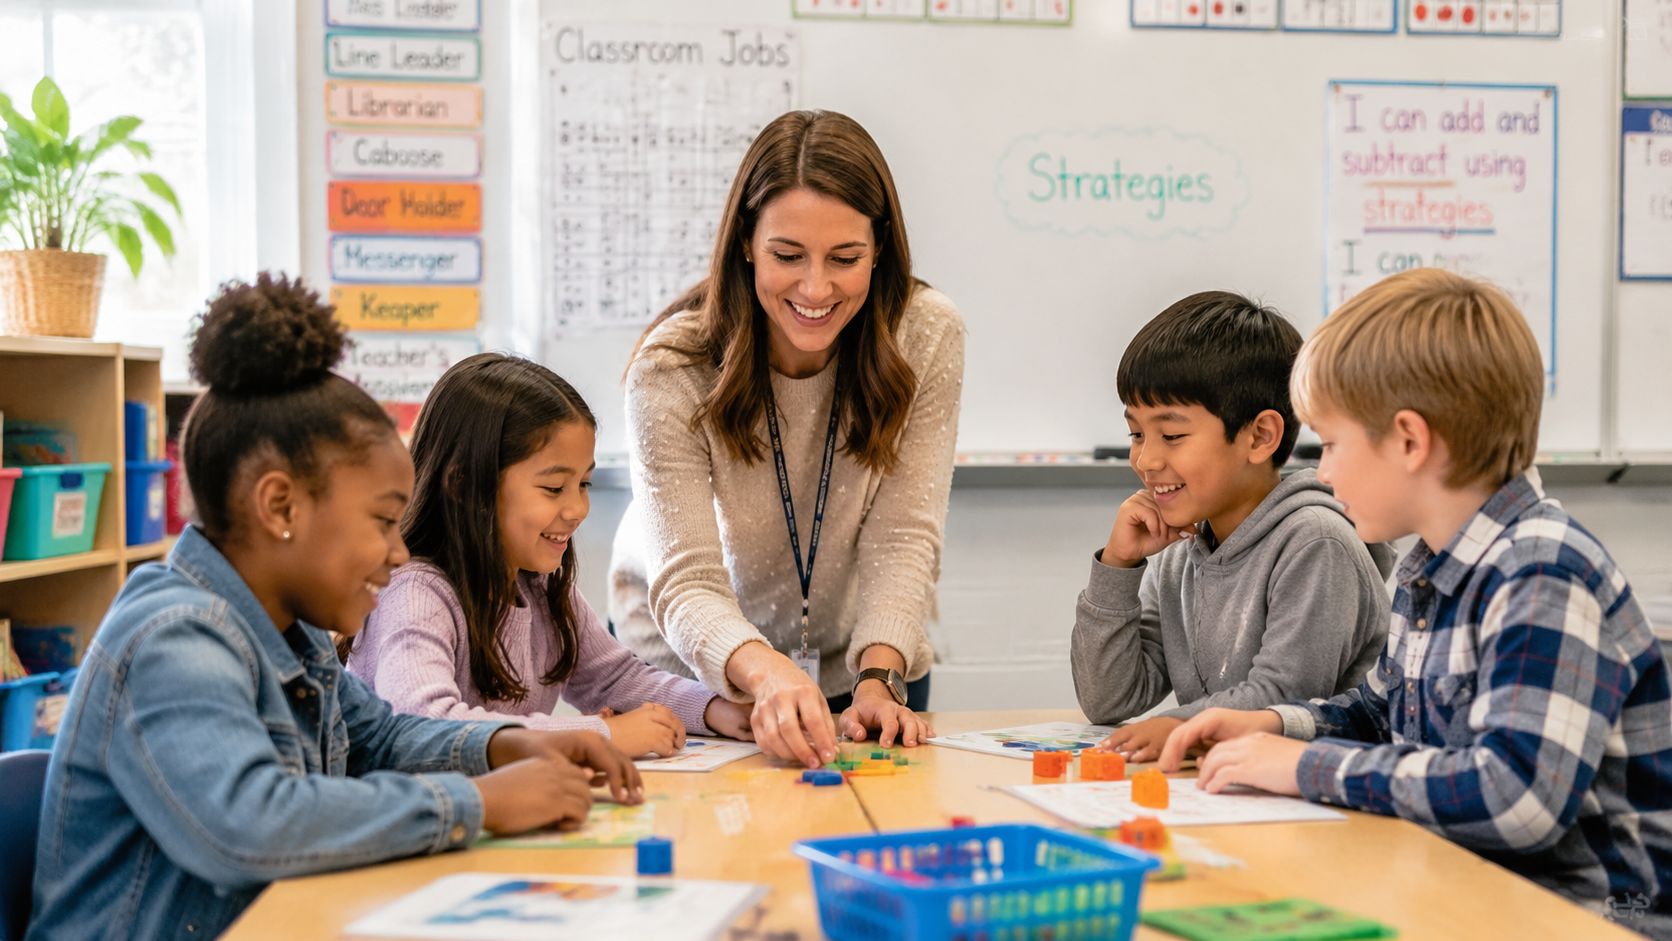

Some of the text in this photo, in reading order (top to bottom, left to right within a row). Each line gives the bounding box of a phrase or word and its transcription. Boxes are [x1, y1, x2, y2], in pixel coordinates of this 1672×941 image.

[334, 38, 464, 70] Line Leader
[554, 26, 790, 67] Classroom Jobs
[348, 88, 448, 118] Librarian
[1343, 94, 1541, 135] I can add and
[353, 137, 444, 168] Caboose
[1342, 141, 1528, 193] subtract using
[398, 187, 464, 219] Holder
[1028, 151, 1216, 221] Strategies
[1363, 188, 1495, 239] strategies
[344, 244, 458, 281] Messenger
[1342, 239, 1362, 276] I
[1377, 250, 1423, 274] can
